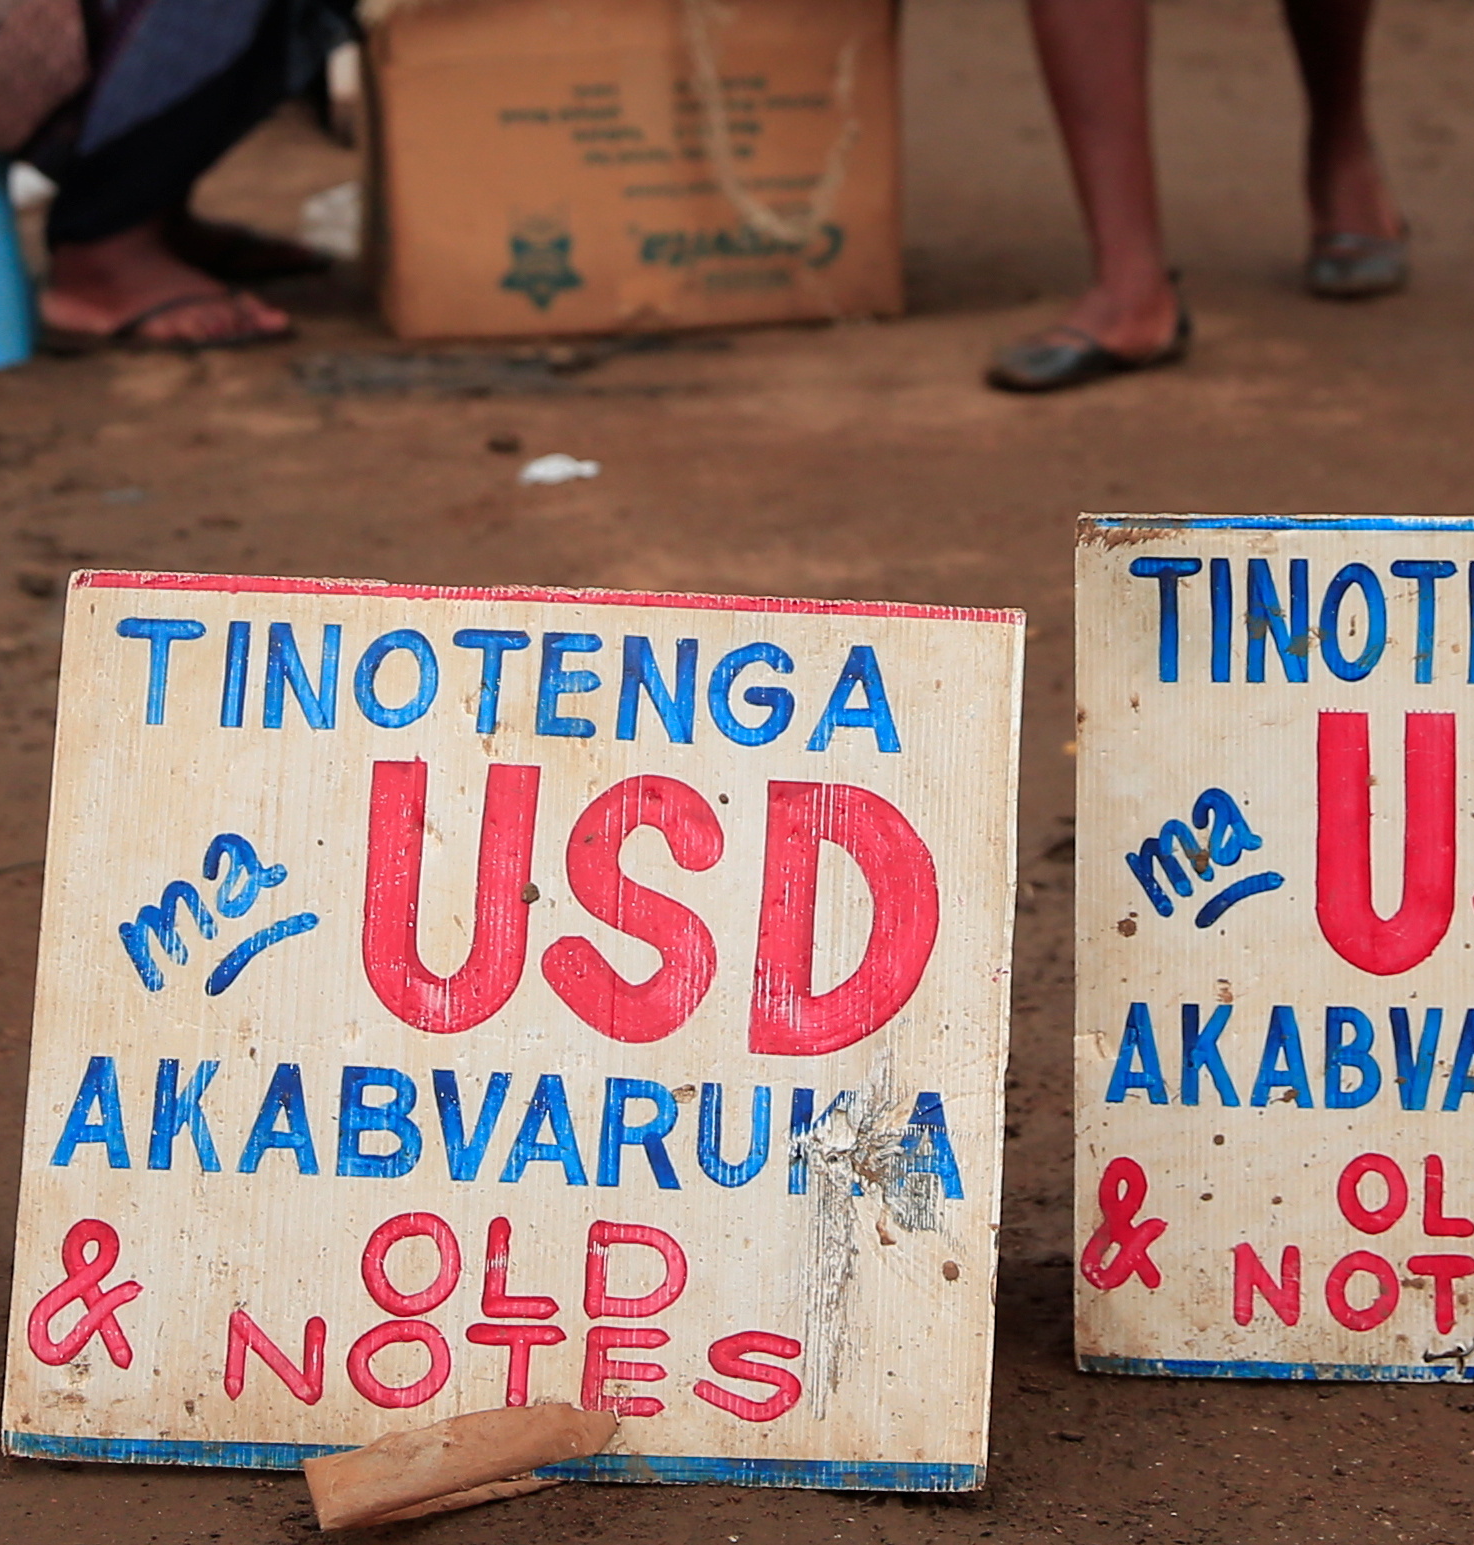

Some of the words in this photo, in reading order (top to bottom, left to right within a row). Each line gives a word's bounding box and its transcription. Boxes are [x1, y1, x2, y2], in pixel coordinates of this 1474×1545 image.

[116, 617, 902, 754] TINOTENGA
[118, 831, 289, 994] ma
[362, 756, 941, 1056] USD
[1125, 786, 1263, 918] ma
[1080, 1156, 1168, 1290] &
[27, 1218, 143, 1370] &
[362, 1212, 688, 1320] OLD
[223, 1309, 803, 1423] NOTES
